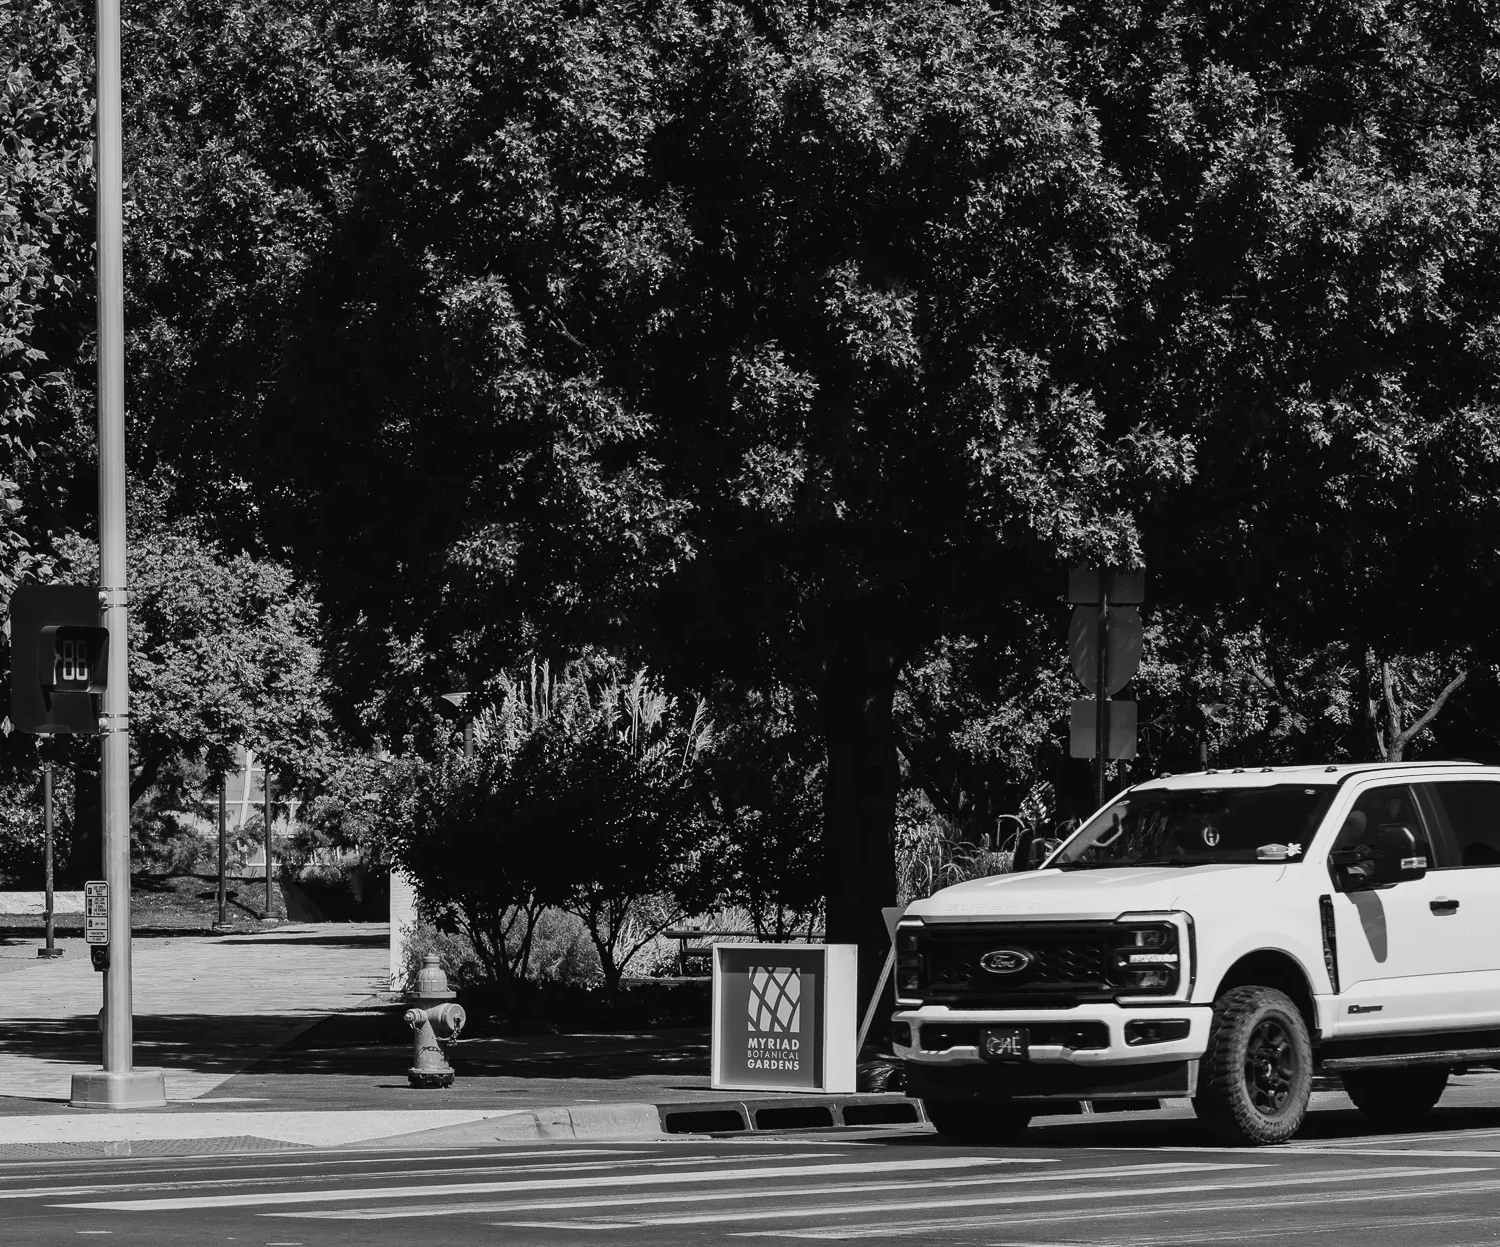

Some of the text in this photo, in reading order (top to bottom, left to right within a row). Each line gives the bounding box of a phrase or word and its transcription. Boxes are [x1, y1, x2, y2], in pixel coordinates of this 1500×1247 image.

[748, 1038, 800, 1050] MYRIAD
[747, 1050, 799, 1060] BOTANICAL
[747, 1059, 799, 1070] GARDENS
